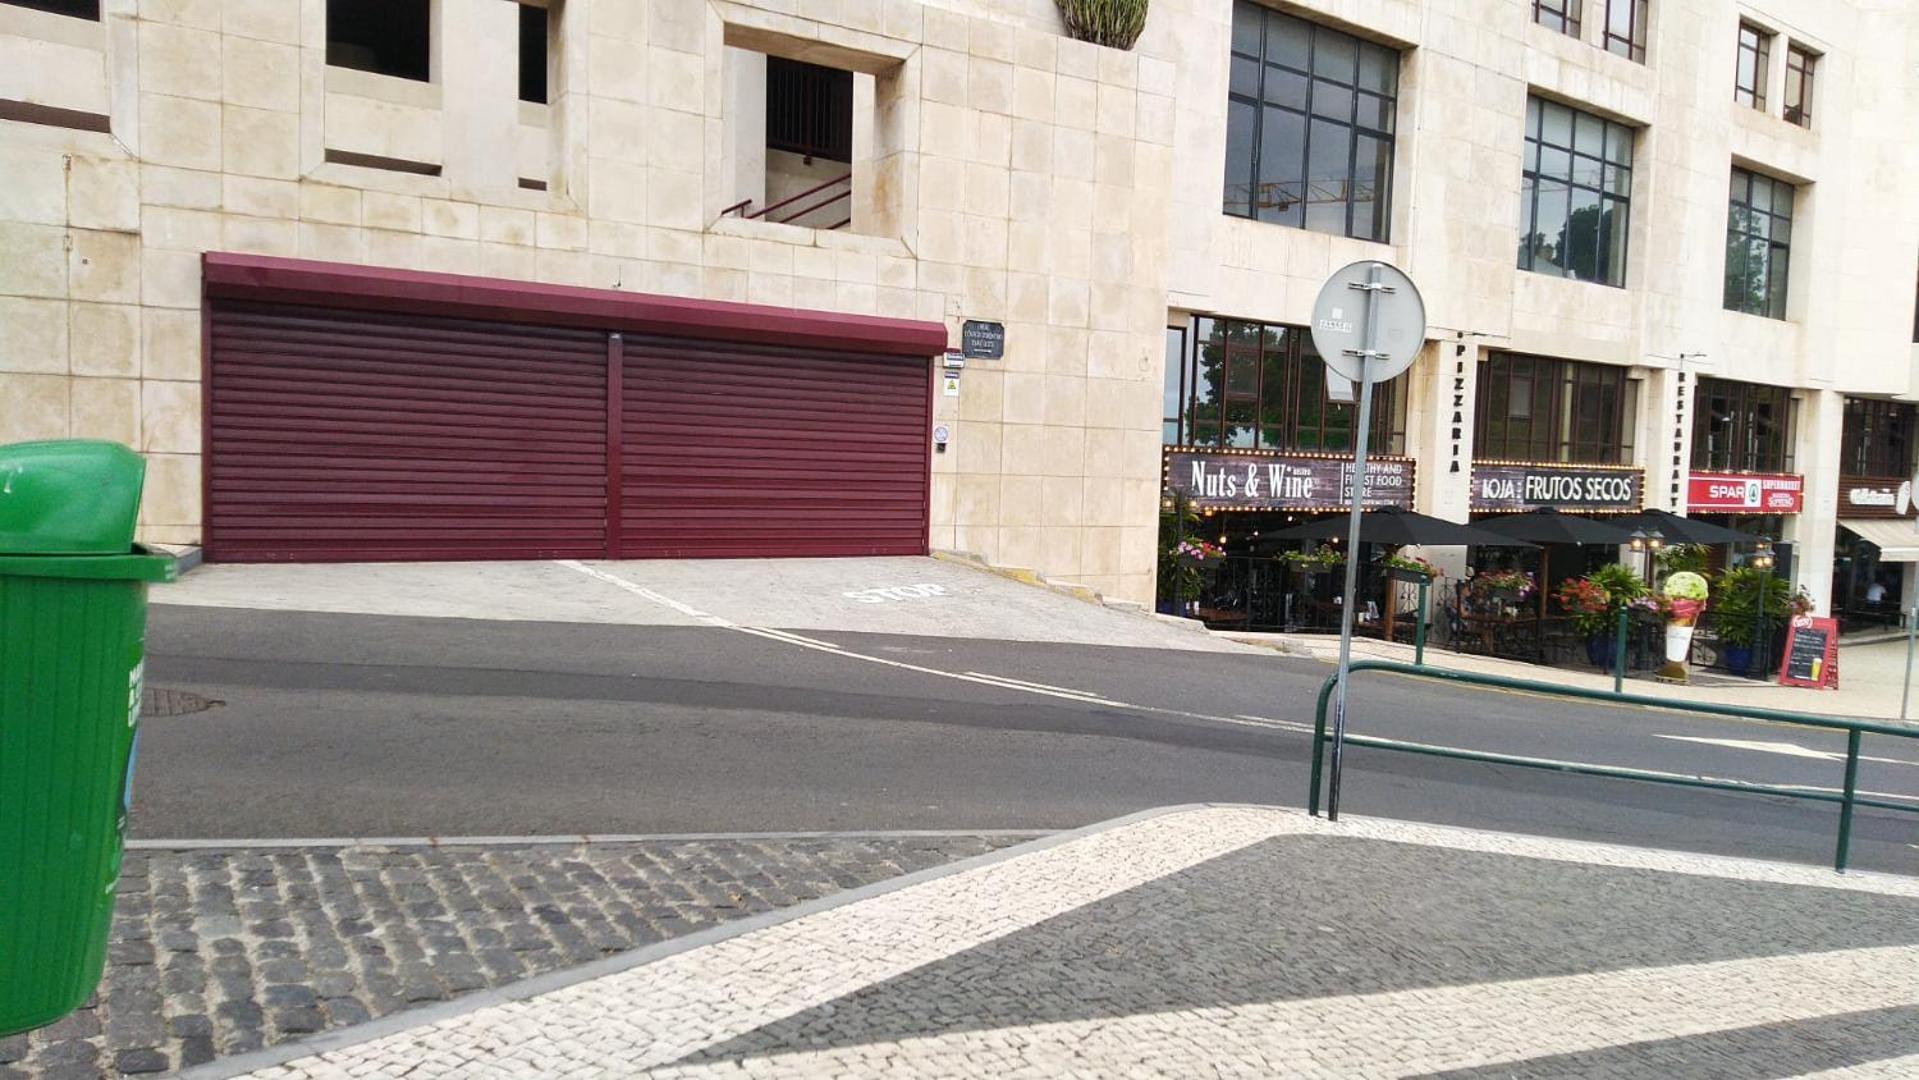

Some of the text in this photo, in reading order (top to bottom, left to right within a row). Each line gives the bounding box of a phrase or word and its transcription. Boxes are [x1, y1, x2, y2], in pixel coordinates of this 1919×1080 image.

[1450, 345, 1465, 473] PIZZARIA
[1670, 372, 1686, 514] RESTAURANT
[1345, 462, 1403, 475] HETHY AND
[1191, 461, 1313, 498] Nuts & Wine
[1345, 474, 1403, 486] FIST FOOD
[1482, 479, 1515, 499] LOJA
[1525, 475, 1582, 500] FRUTOS
[1585, 476, 1632, 501] SECOS
[1344, 486, 1372, 498] STRE
[1709, 485, 1745, 499] SPAR
[842, 583, 946, 603] STOP
